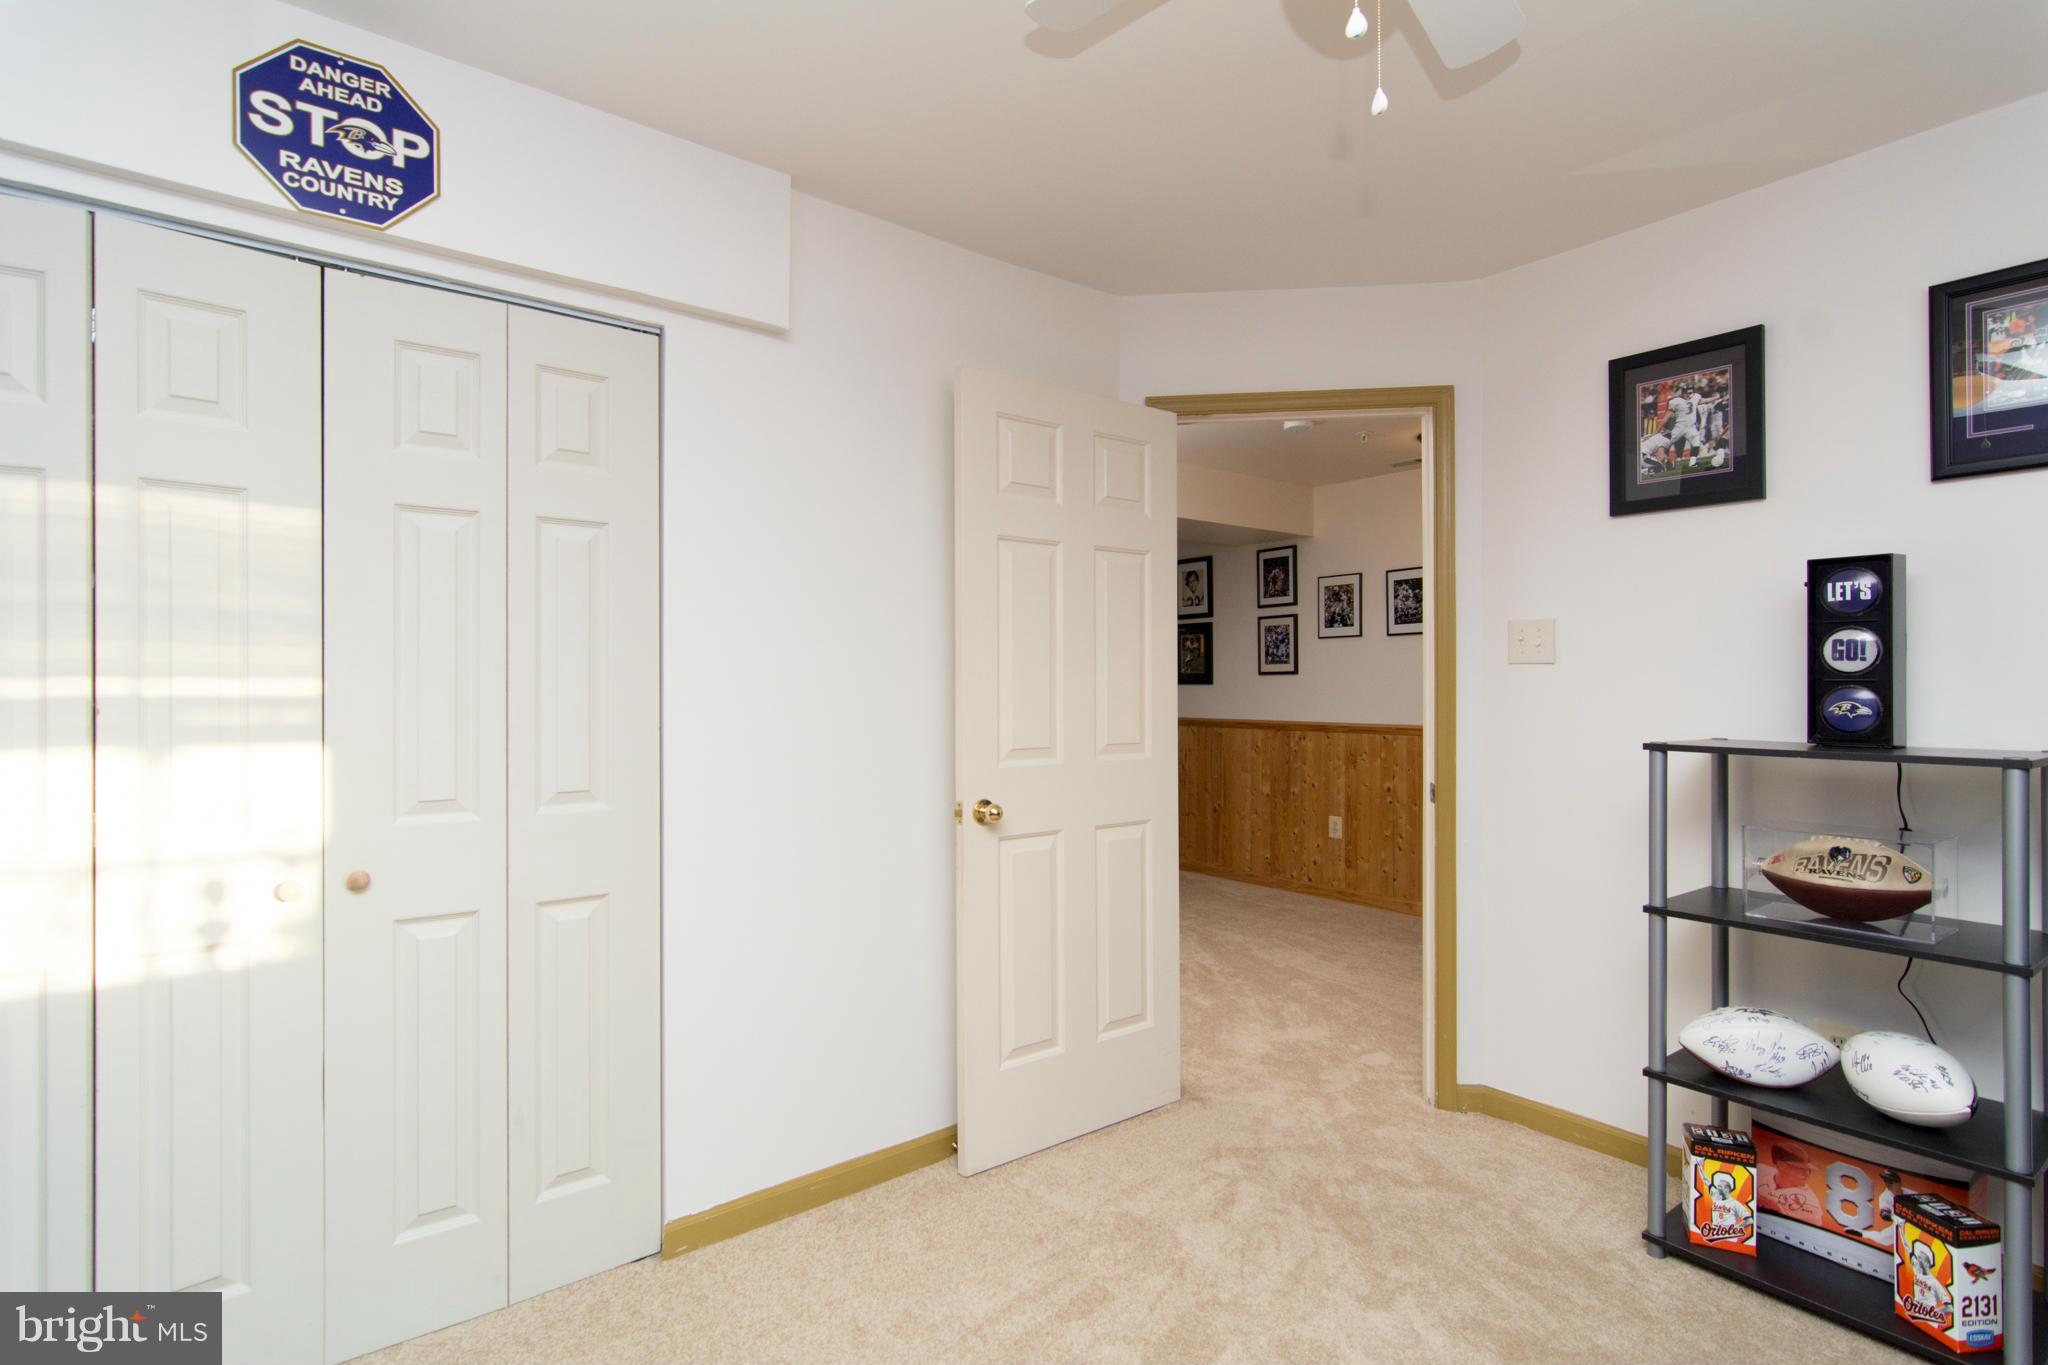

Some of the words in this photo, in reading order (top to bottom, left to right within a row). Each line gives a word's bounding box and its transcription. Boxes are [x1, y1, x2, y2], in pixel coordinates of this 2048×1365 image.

[289, 54, 392, 98] DANGER
[298, 77, 383, 113] AHEAD
[248, 90, 430, 168] STOP
[279, 149, 404, 195] RAVENS
[282, 171, 399, 211] COUNTRY
[1827, 581, 1872, 602] LET'S
[1831, 638, 1867, 662] GO!
[1793, 853, 1892, 883] RAVENS
[1695, 1144, 1714, 1153] CAL
[1825, 1161, 1874, 1230] 8
[1701, 1222, 1746, 1239] Orioles
[1903, 1295, 1946, 1322] Orioles
[1961, 1295, 1998, 1318] 2131
[1961, 1318, 1998, 1327] EDITION
